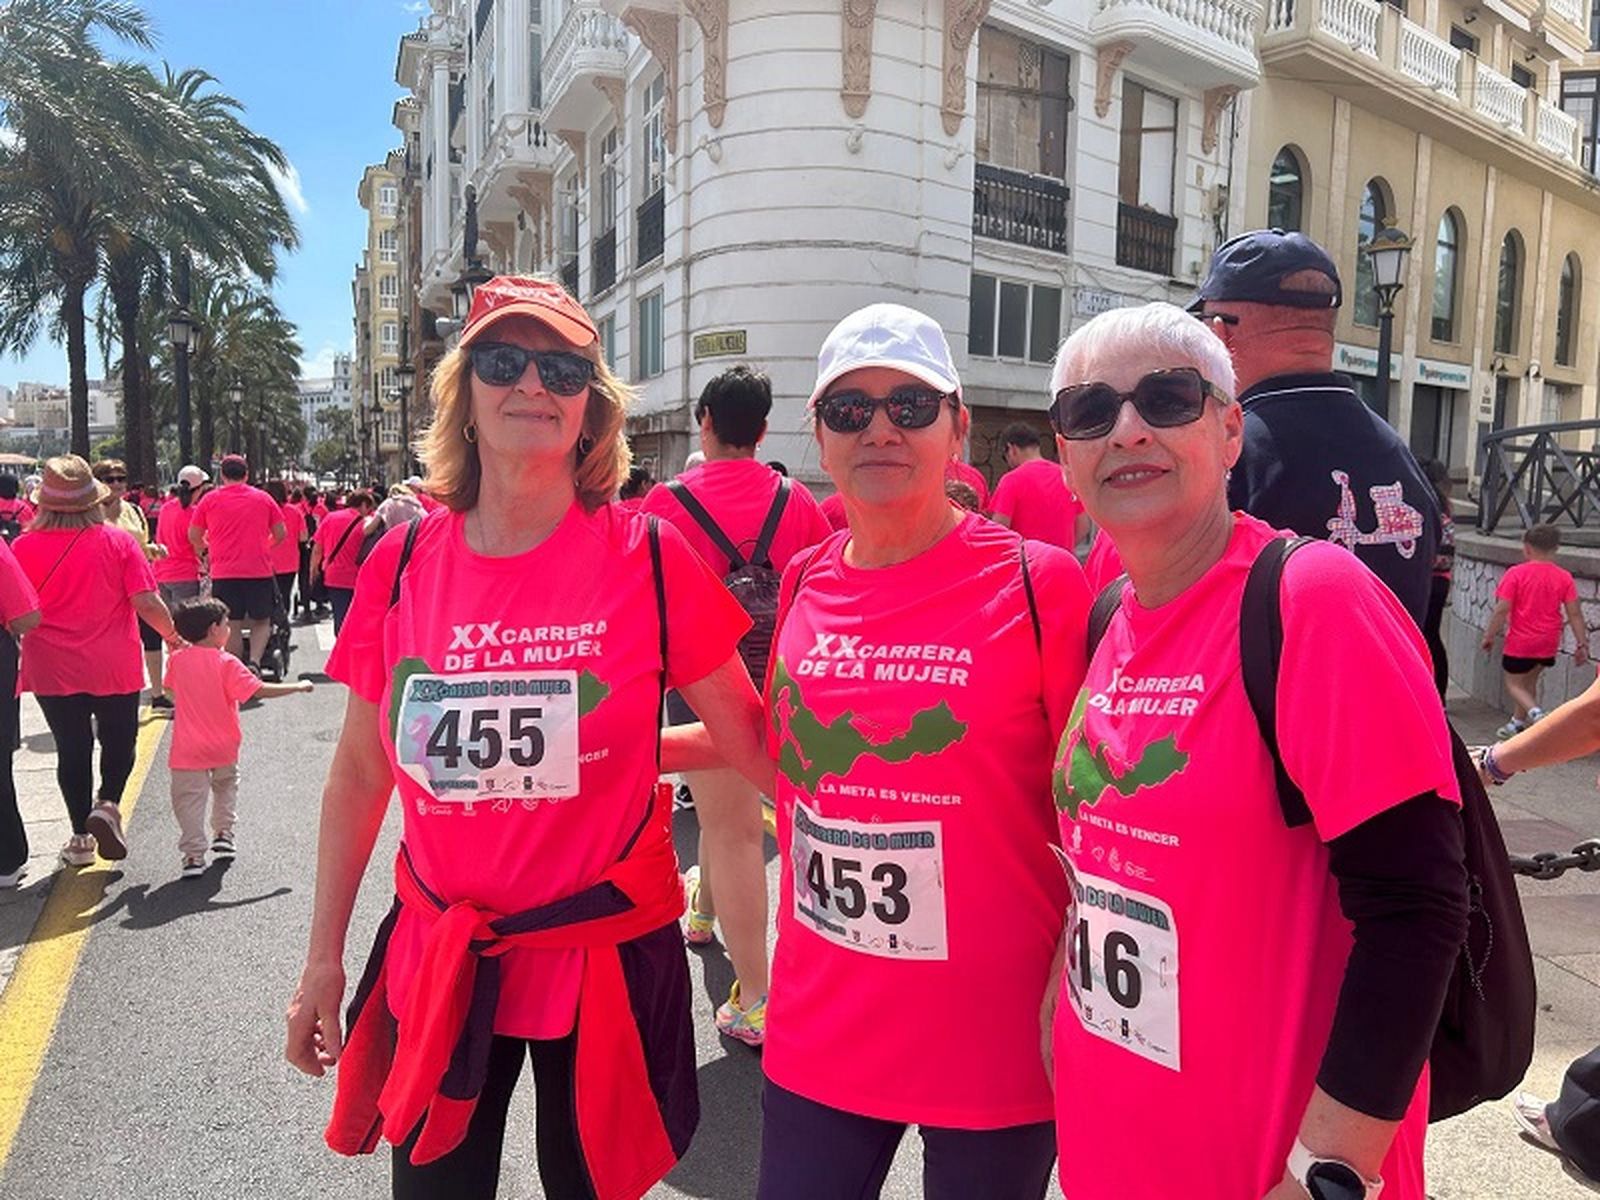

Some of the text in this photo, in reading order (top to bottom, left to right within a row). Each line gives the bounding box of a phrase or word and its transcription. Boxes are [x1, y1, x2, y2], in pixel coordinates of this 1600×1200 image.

[445, 640, 602, 671] DE LA MUJER
[797, 660, 969, 687] DE LA MUJER
[490, 680, 510, 696] DE
[511, 680, 527, 696] LA
[528, 679, 572, 695] MUJER
[1128, 697, 1199, 716] MUJER
[426, 707, 545, 770] 455
[820, 783, 961, 805] LA META ES VENCER
[852, 831, 871, 849] DE
[871, 833, 888, 850] LA
[889, 831, 936, 849] MUJER
[1130, 826, 1180, 847] VENCER
[807, 850, 911, 925] 453
